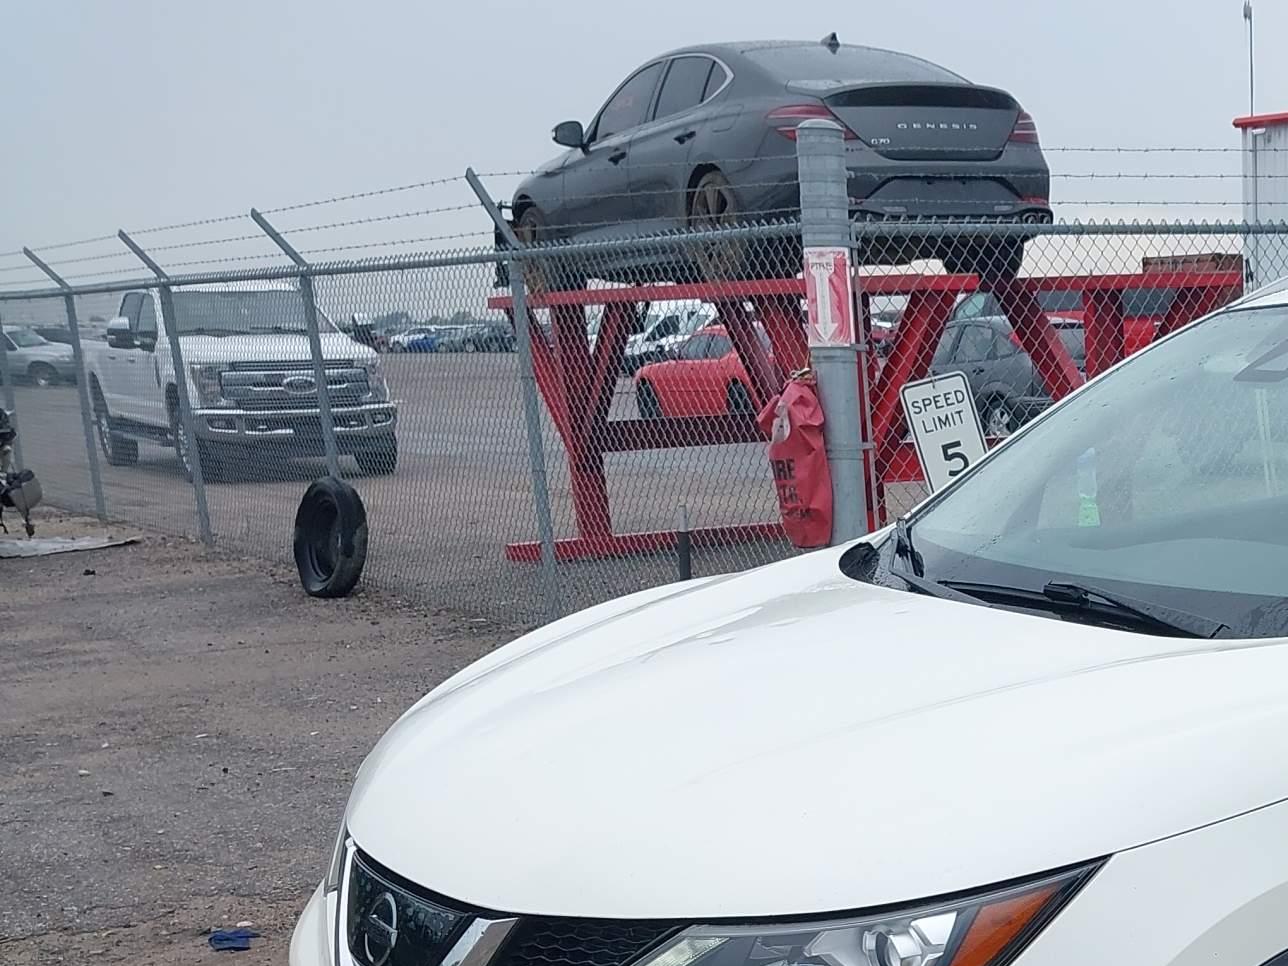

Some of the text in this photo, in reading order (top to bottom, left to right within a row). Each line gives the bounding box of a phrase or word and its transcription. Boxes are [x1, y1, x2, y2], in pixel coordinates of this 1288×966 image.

[911, 390, 965, 415] SPEED
[922, 409, 964, 433] LIMIT
[941, 440, 970, 477] 5
